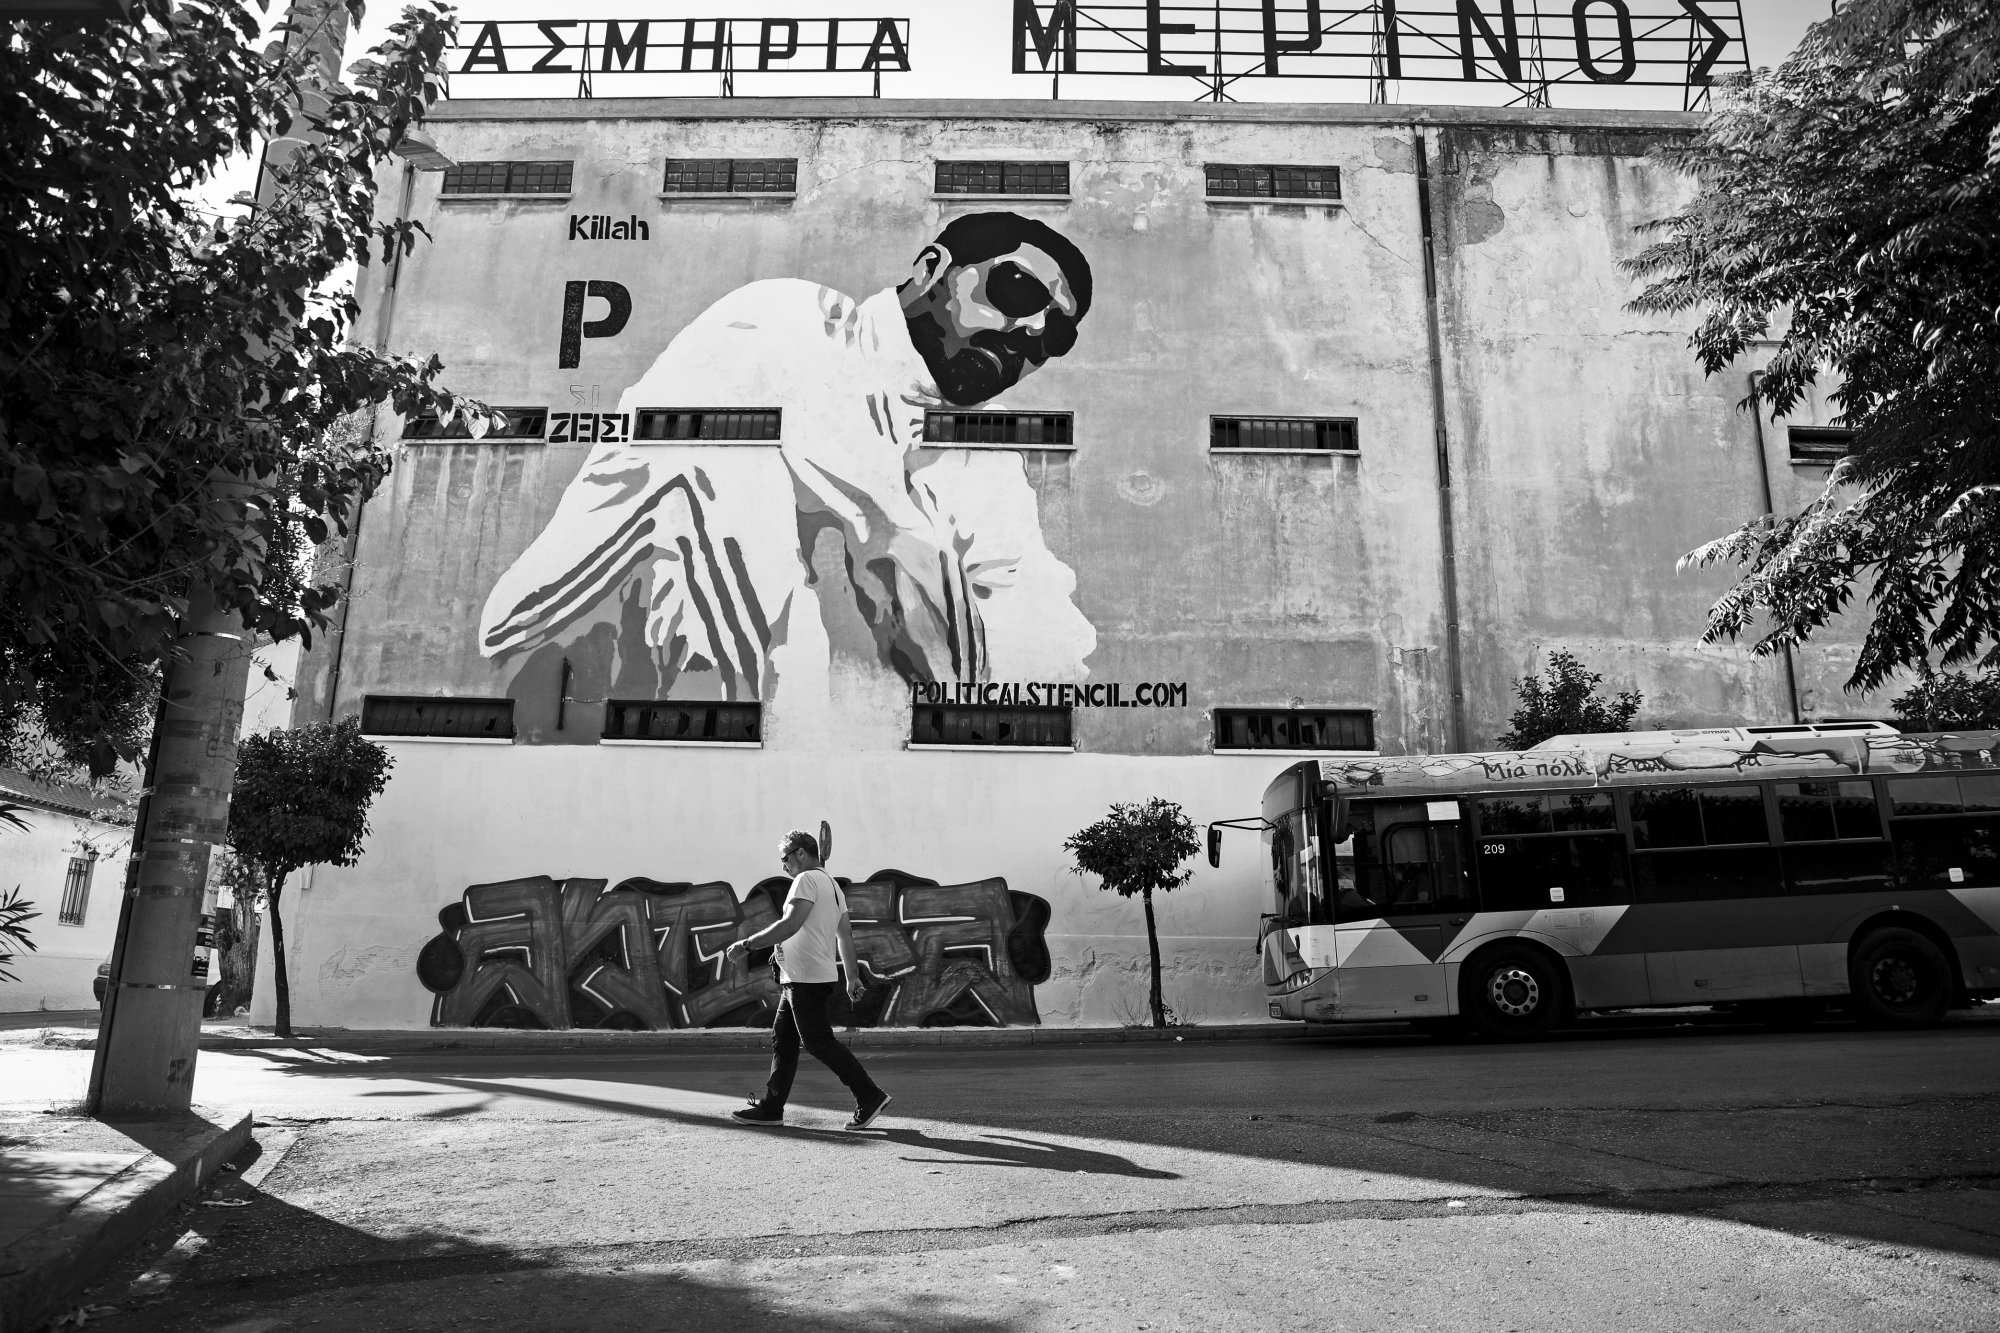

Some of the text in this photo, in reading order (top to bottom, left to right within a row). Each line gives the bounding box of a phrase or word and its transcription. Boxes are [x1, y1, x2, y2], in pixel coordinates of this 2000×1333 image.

[440, 18, 911, 73] ΑΣΜΗΡΙΑ
[568, 214, 650, 241] Killah
[912, 681, 1187, 708] POLITICALSTENCIL.COM
[1483, 843, 1505, 855] 209
